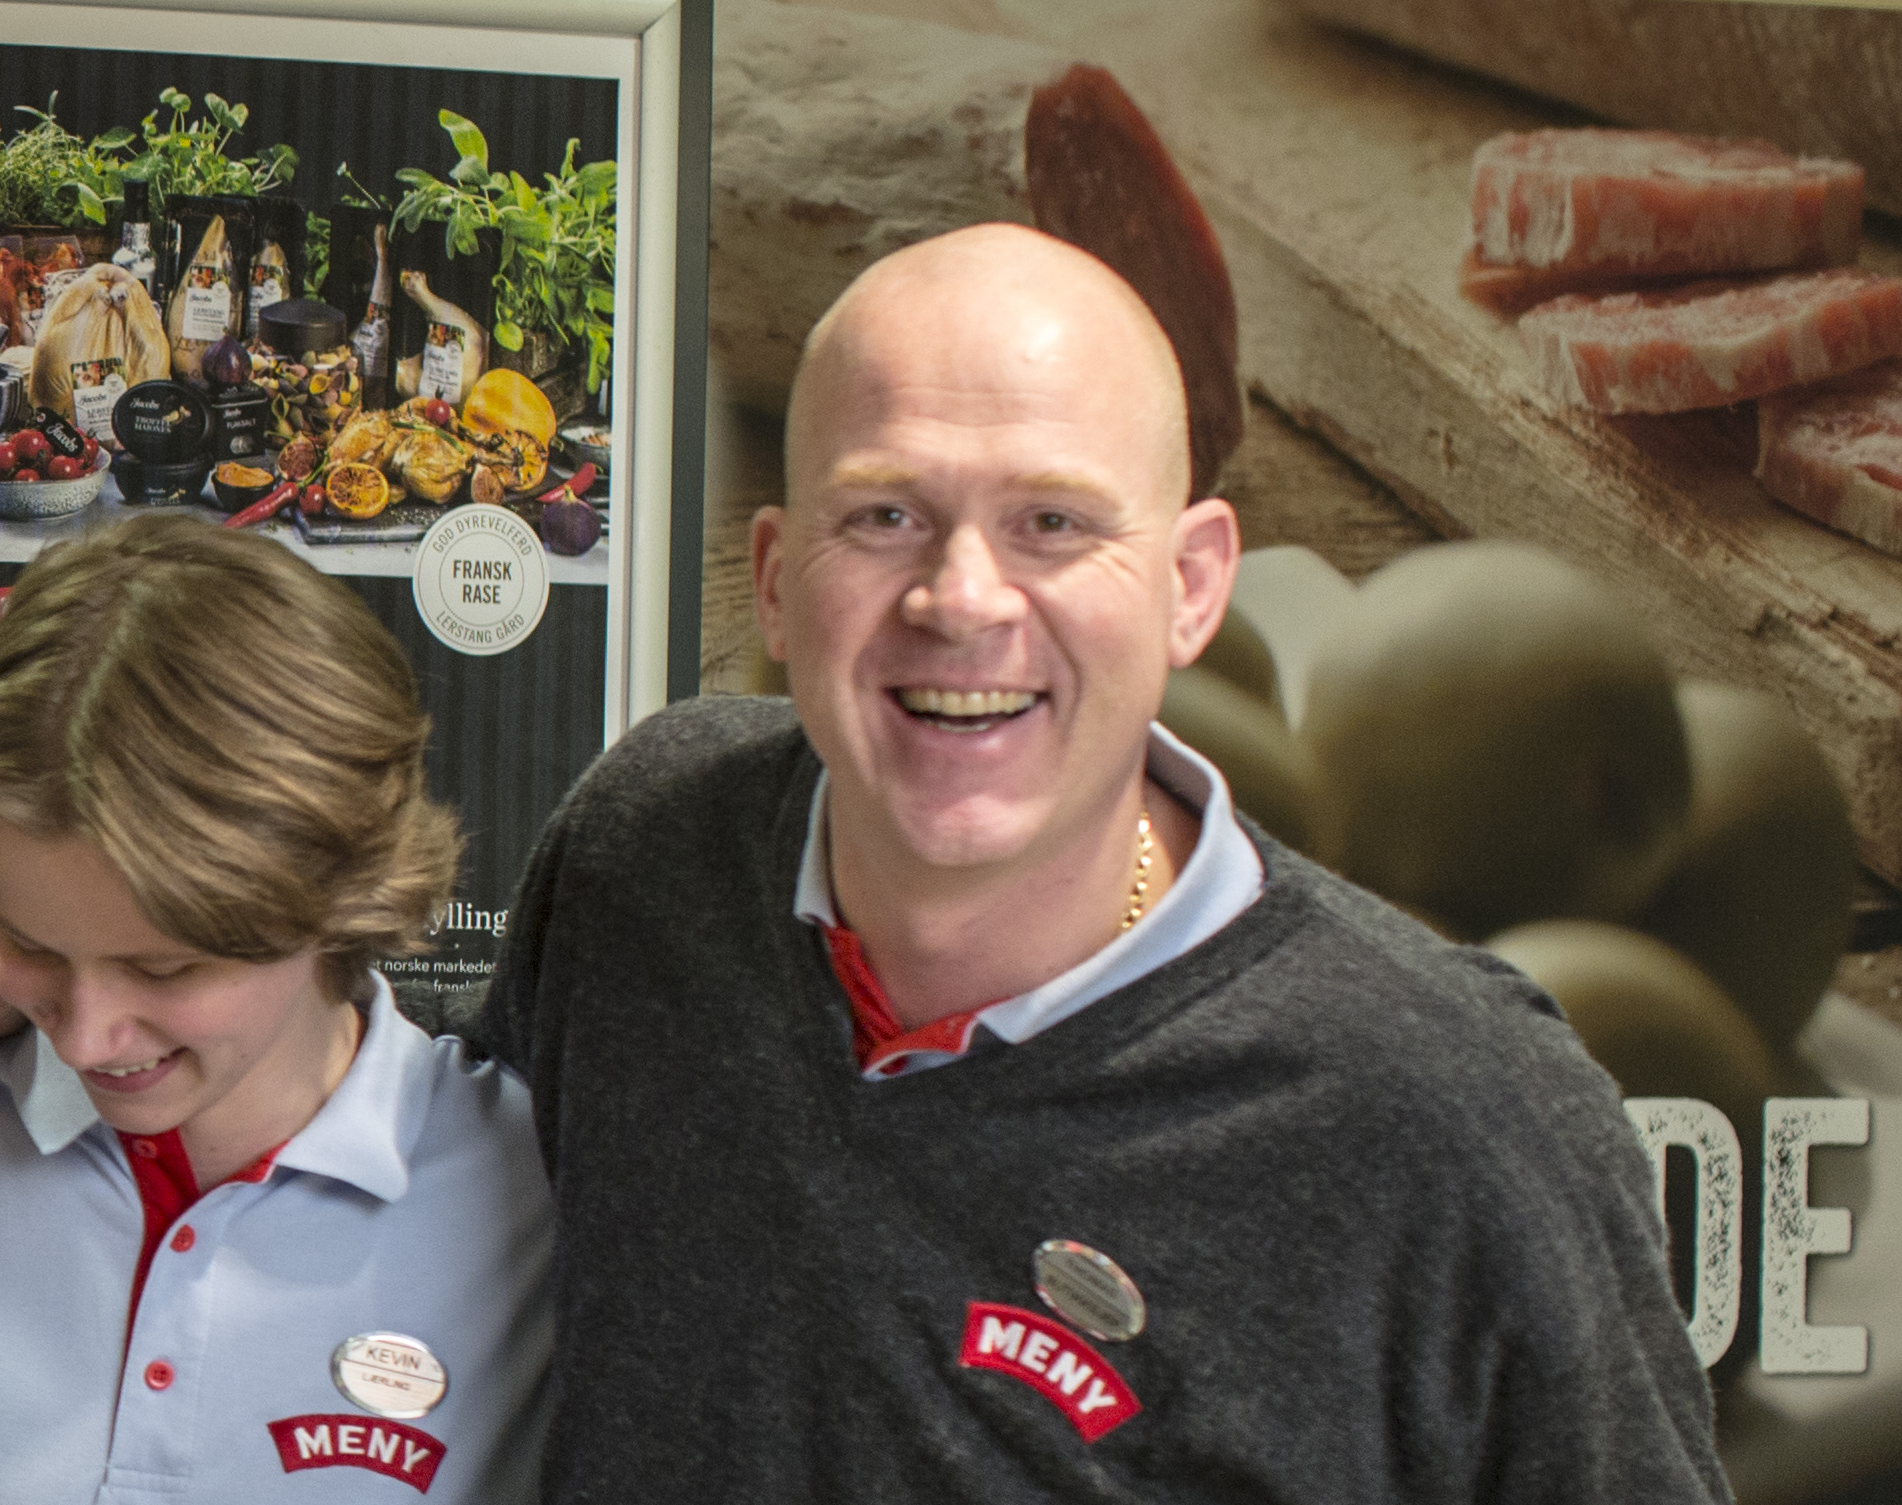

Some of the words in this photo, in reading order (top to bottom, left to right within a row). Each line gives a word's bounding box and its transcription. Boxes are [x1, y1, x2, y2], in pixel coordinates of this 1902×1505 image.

[432, 528, 455, 553] GOD
[455, 515, 532, 556] DYREVELFERD
[452, 559, 512, 581] FRANSK
[462, 584, 501, 604] RASE
[436, 610, 493, 644] LERSTANG
[495, 613, 525, 640] GÅRD
[429, 902, 509, 938] ylling
[385, 958, 430, 972] norske
[366, 1347, 422, 1370] KEVIN
[977, 1315, 1117, 1414] MENY
[295, 1424, 431, 1474] MENY
